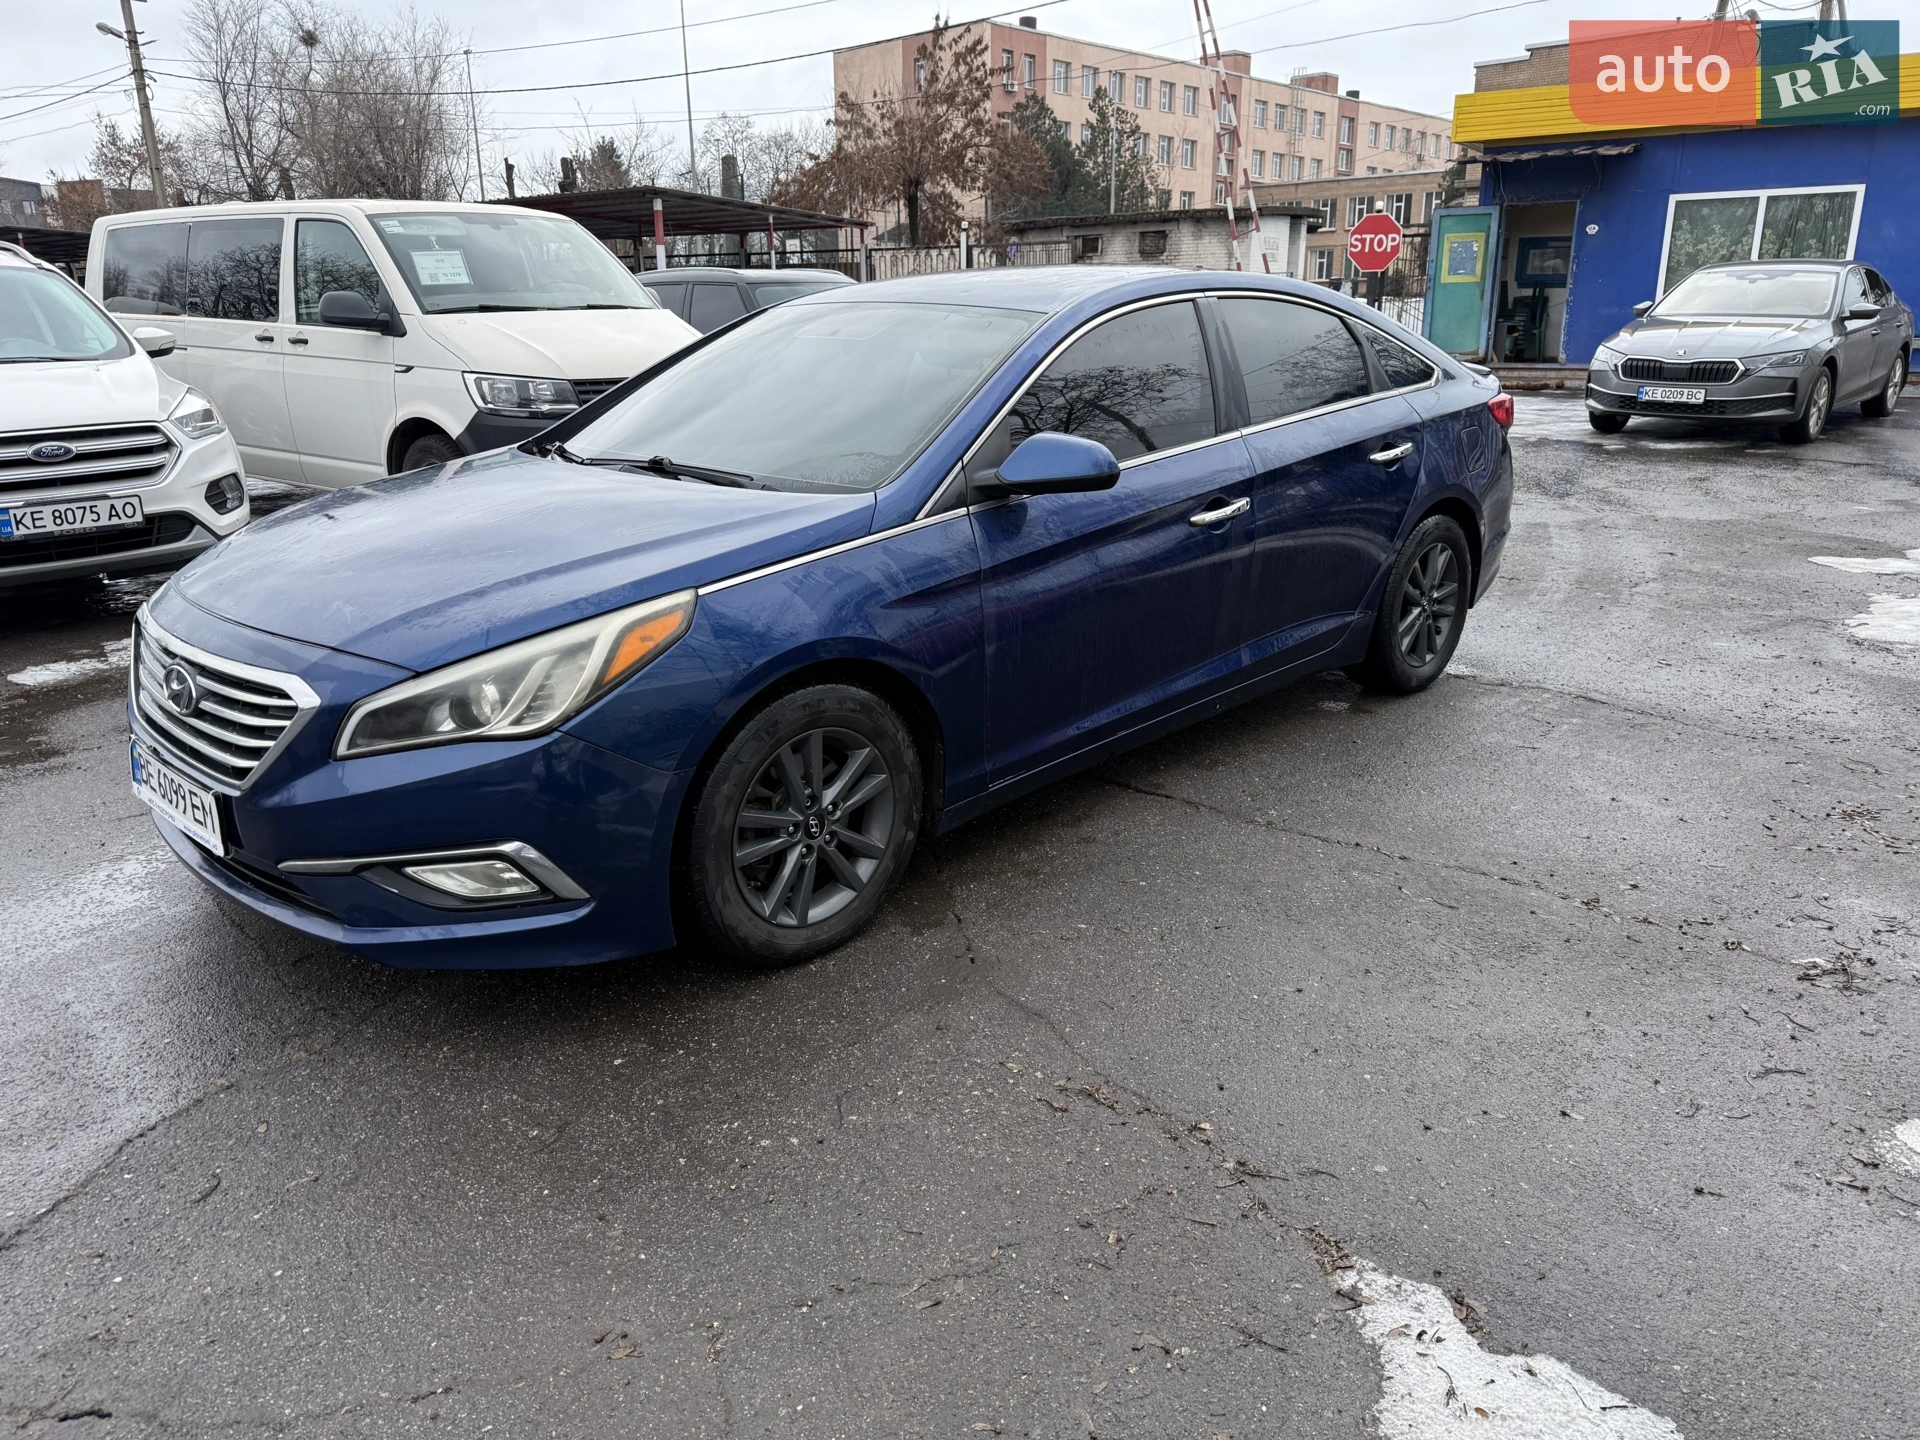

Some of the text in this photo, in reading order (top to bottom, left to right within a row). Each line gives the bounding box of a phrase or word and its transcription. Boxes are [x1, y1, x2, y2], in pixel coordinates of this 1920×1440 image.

[1350, 233, 1400, 253] STOP
[1644, 388, 1702, 401] KE 0209 BC
[41, 446, 65, 457] Ford
[13, 501, 137, 531] KE 8075 AO
[138, 751, 158, 794] BE
[158, 768, 187, 816] 6099
[188, 788, 216, 835] EM
